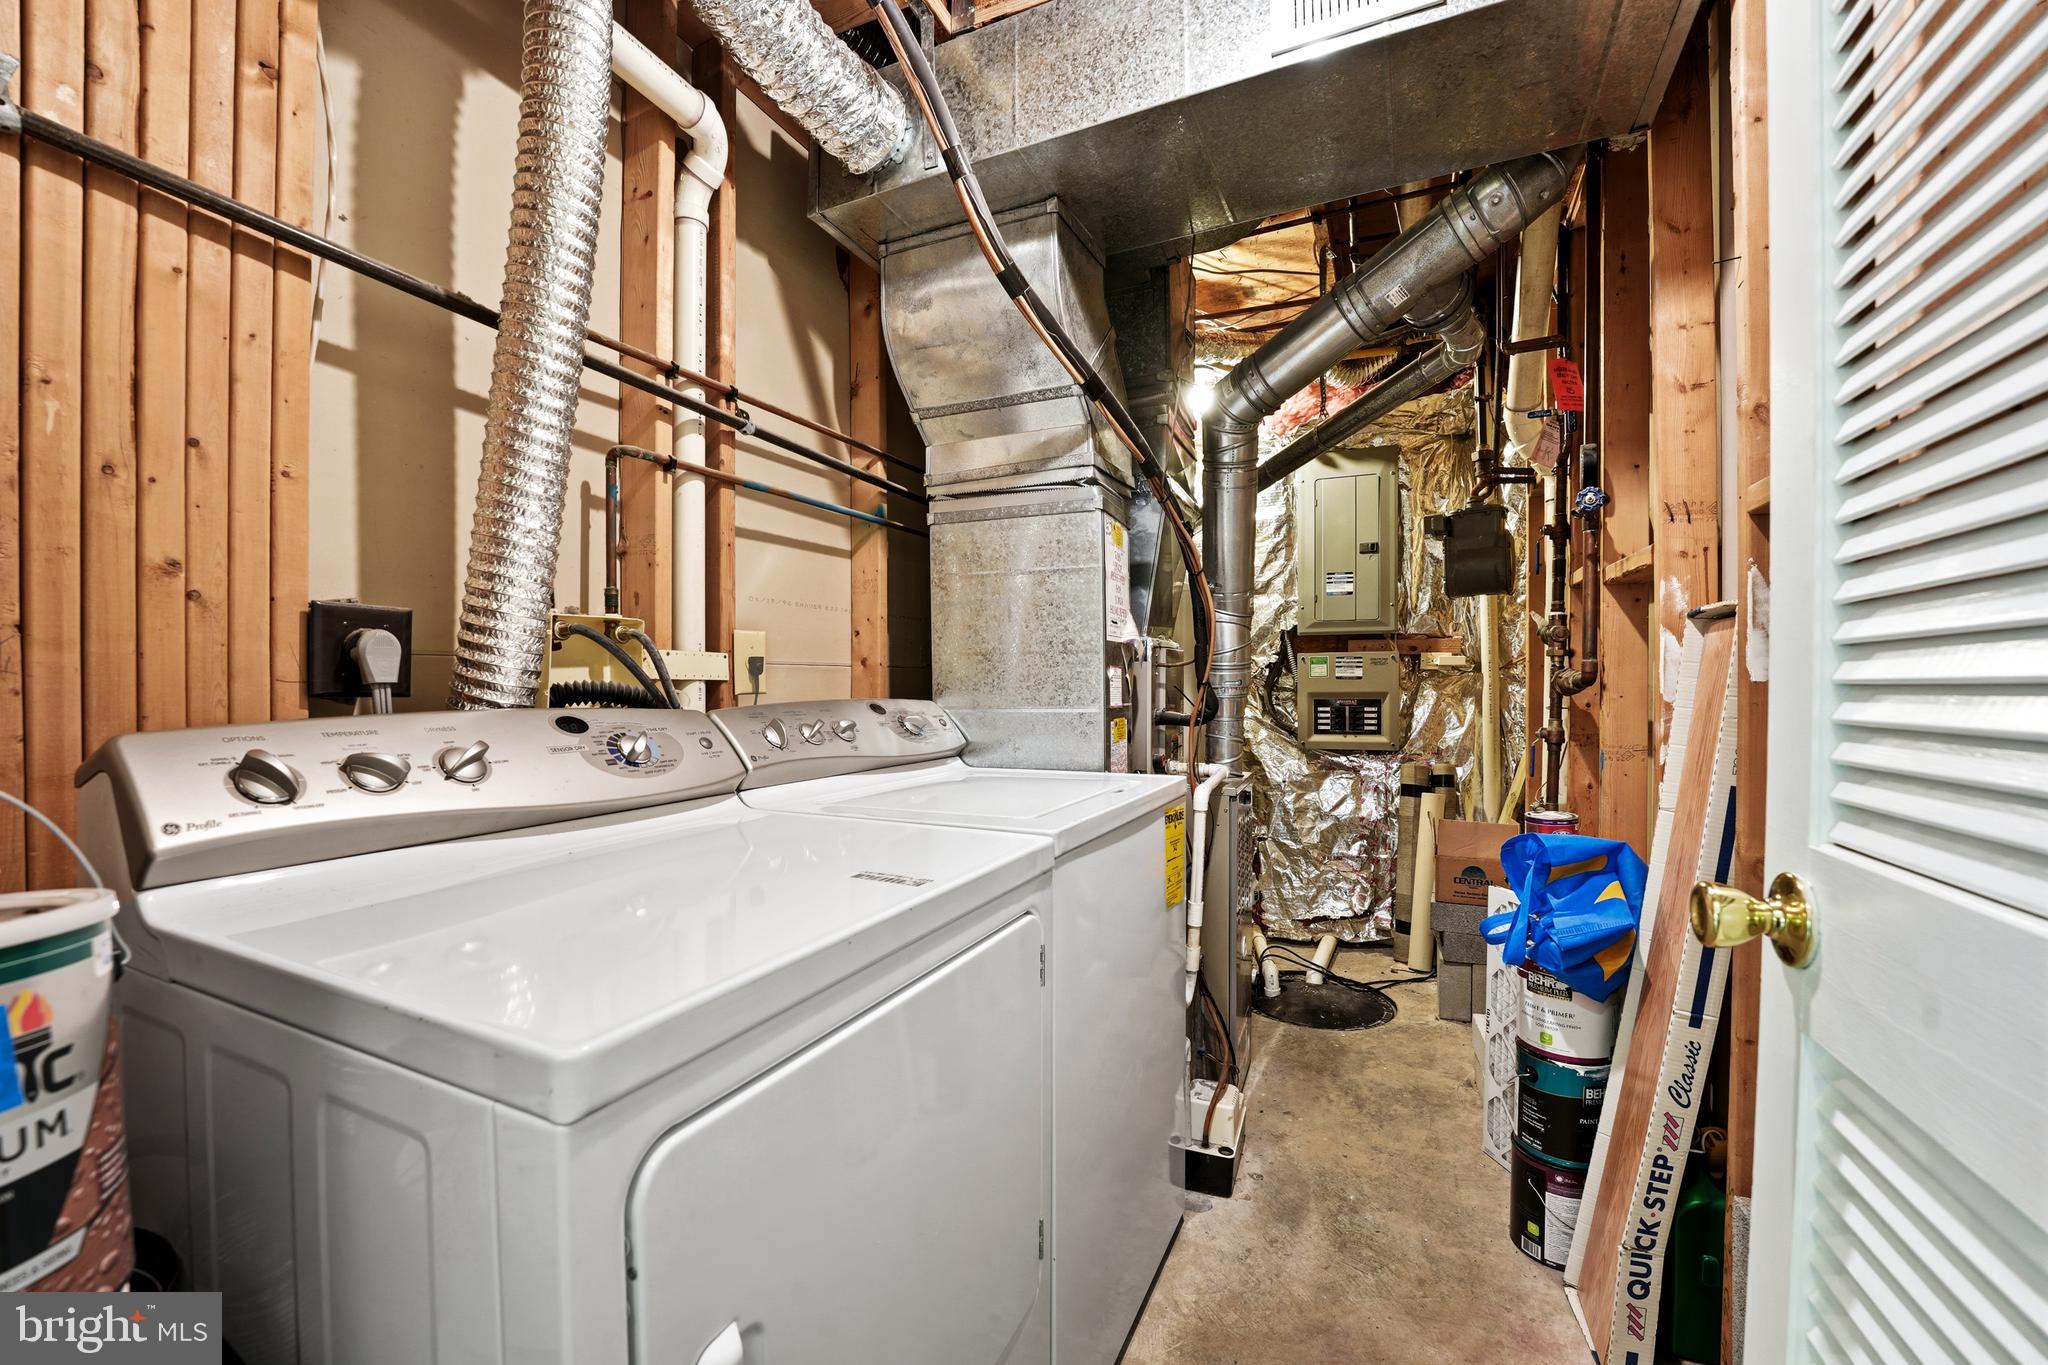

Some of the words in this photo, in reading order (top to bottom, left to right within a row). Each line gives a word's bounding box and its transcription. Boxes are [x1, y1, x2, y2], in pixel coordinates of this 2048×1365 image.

[222, 735, 266, 743] OPTIONS
[321, 729, 379, 738] TEMPERATURE
[550, 745, 573, 753] SENSOR
[186, 819, 223, 832] Profile
[1454, 876, 1494, 886] CENTRAL
[1528, 970, 1554, 988] BEHR
[1668, 1040, 1702, 1109] Classic
[1585, 1088, 1606, 1099] BEH
[0, 1108, 68, 1163] UM
